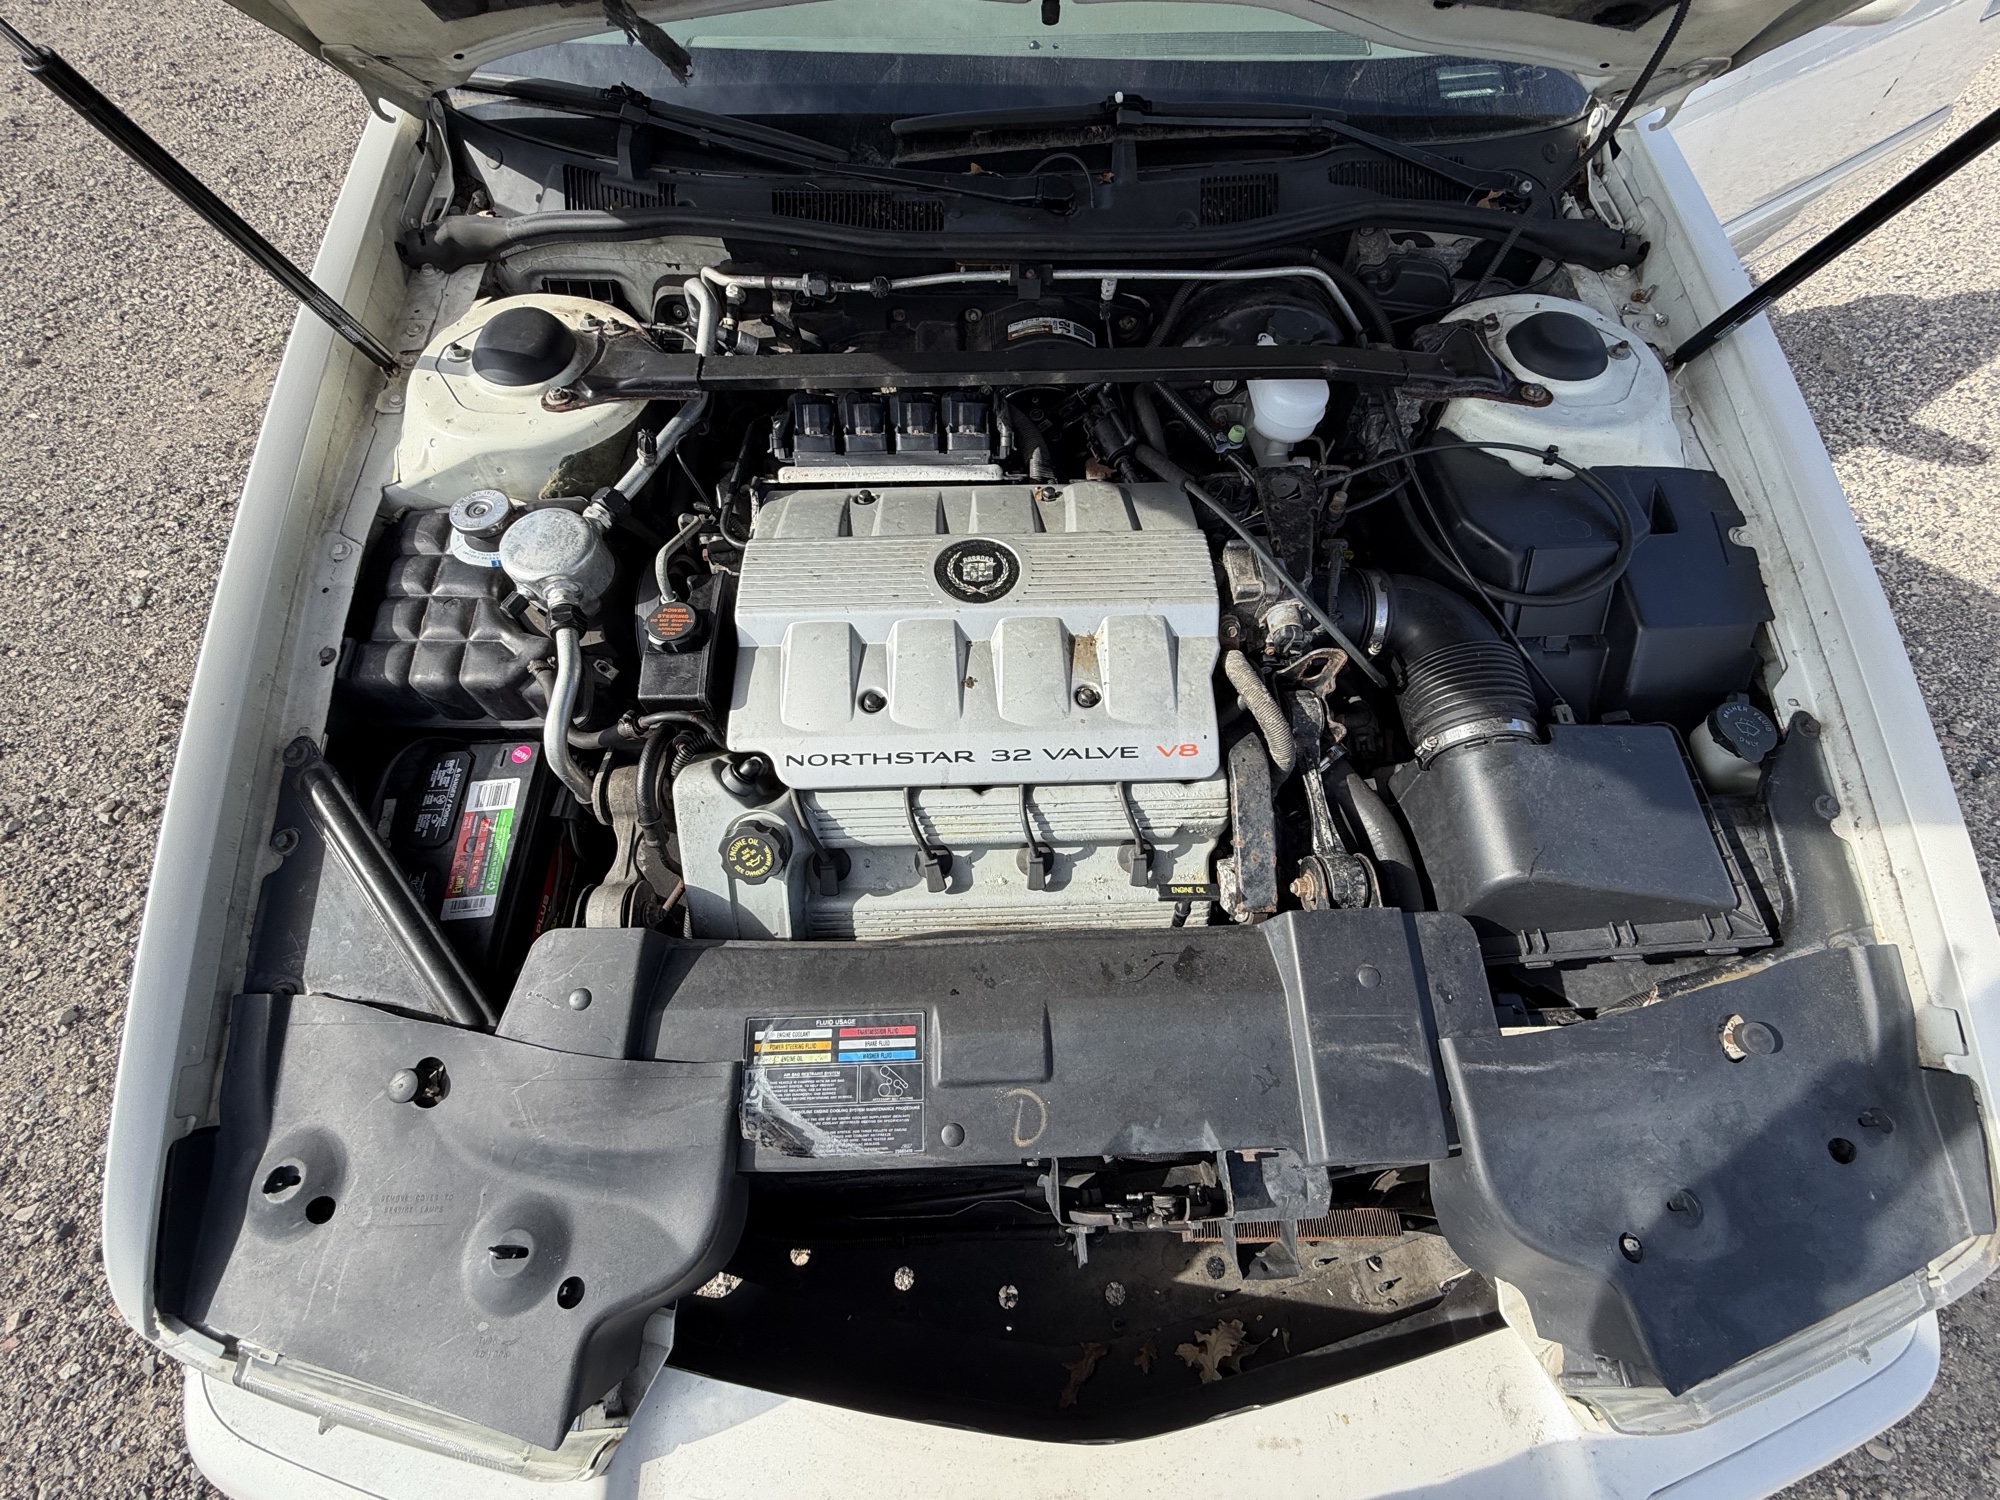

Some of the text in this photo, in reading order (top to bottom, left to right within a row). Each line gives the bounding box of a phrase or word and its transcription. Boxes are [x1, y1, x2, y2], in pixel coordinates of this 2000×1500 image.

[1723, 706, 1772, 732] WASHER FLUID
[1739, 737, 1759, 747] ONLY
[786, 744, 1198, 767] NORTHSTAR 32 VALVE V8
[449, 774, 461, 798] DANGER
[441, 803, 452, 827] POISON
[730, 838, 747, 861] ENGINE
[748, 838, 759, 846] OIL
[536, 894, 549, 933] PLUS
[415, 1194, 438, 1202] COVER
